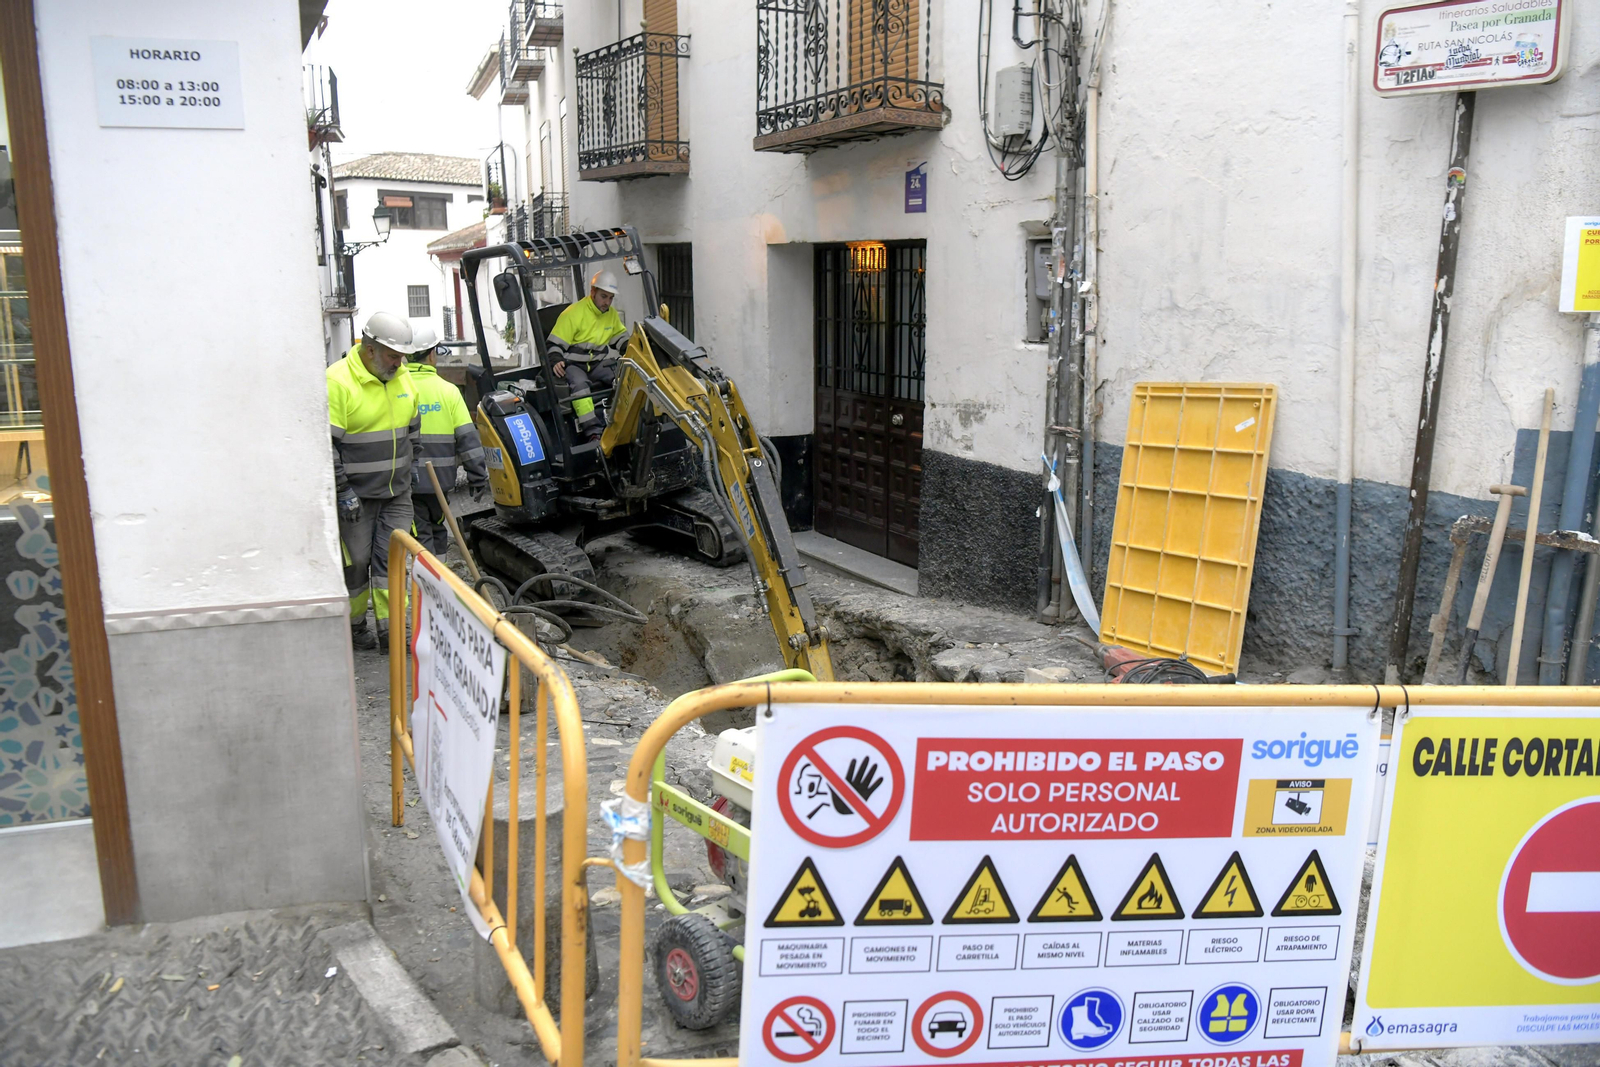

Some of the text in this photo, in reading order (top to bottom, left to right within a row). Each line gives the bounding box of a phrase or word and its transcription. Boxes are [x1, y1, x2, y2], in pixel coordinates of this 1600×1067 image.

[1438, 0, 1553, 20] Itinerarios Saludables
[1450, 9, 1552, 32] Pasea por Granada
[1418, 31, 1513, 51] RUTA SAN NICOLÁS
[129, 48, 201, 61] HORARIO
[116, 79, 219, 92] 08:00 a 13:00
[119, 94, 221, 107] 15:00 a 20:00
[468, 623, 495, 676] PARA
[453, 650, 497, 725] GRANADA
[926, 750, 1225, 772] PROHIBIDO EL PASO
[1412, 736, 1600, 777] CALLE CORTA
[1288, 780, 1312, 788] AVISO
[967, 781, 1181, 803] SOLO PERSONAL
[990, 811, 1159, 833] AUTORIZADO
[1278, 826, 1333, 834] VIDEOVIGILADA
[1211, 937, 1239, 945] RIESGO
[1311, 934, 1321, 942] DE
[777, 943, 828, 951] MAQUINARIA
[984, 943, 995, 951] DE
[1042, 940, 1070, 950] CAÍDAS
[1127, 939, 1162, 947] MATERIAS
[1276, 943, 1328, 951] ATRAPAMIENTO
[863, 946, 905, 954] CAMIONES
[1119, 948, 1168, 956] INFLAMABLES
[1204, 944, 1243, 953] ELÉCTRICO
[865, 955, 916, 963] MOVIMIENTO
[1037, 951, 1064, 959] MISMO
[776, 961, 827, 970] MOVIMIENTO
[1138, 1001, 1187, 1009] OBLIGATORIO
[1137, 1017, 1172, 1025] CALZADO
[1271, 1016, 1317, 1024] REFLECTANTE
[1523, 1014, 1569, 1023] Trabajamos
[1570, 1014, 1589, 1022] para
[1012, 1021, 1046, 1029] VEHÍCULOS
[1387, 1022, 1458, 1036] emasagra
[1516, 1022, 1600, 1033] DISCULPE LAS MOLES
[1188, 1056, 1251, 1067] TODAS
[1256, 1054, 1290, 1067] LAS
